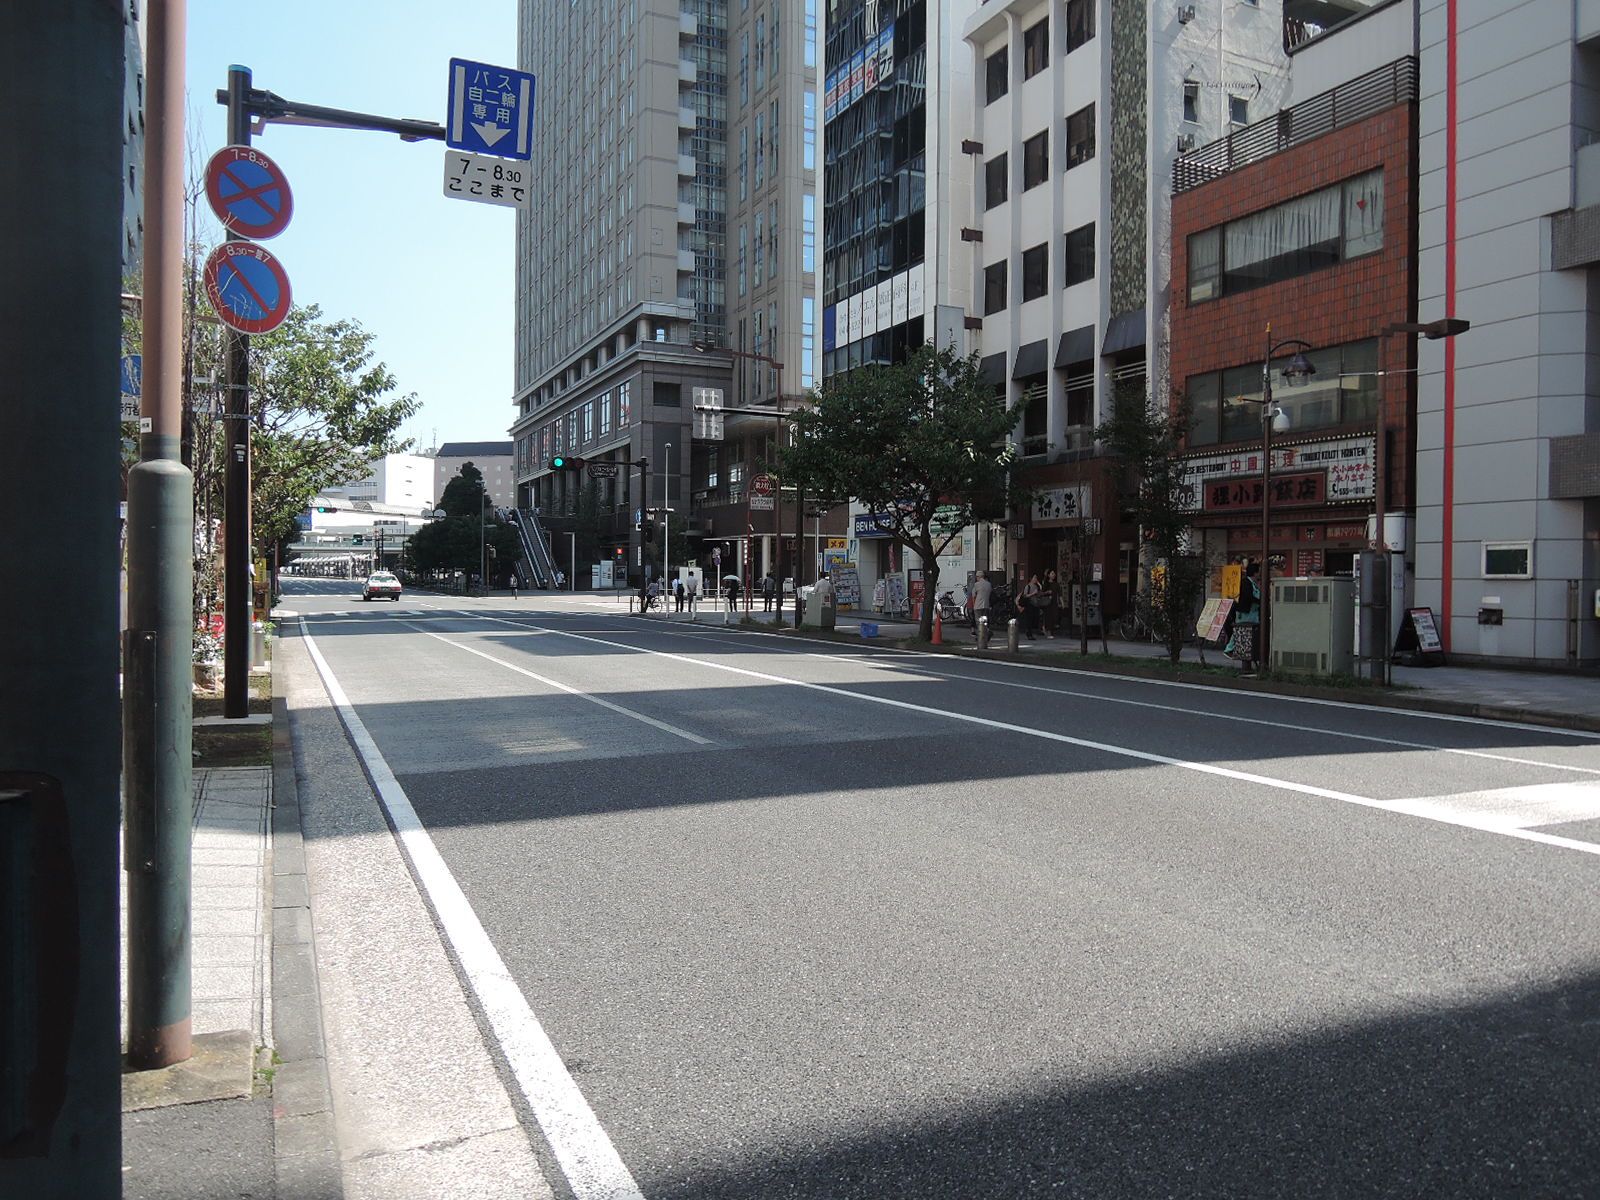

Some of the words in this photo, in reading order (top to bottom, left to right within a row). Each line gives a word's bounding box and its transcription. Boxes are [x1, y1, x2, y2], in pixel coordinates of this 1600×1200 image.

[473, 69, 512, 90] バス
[468, 86, 517, 110] 自二輪
[472, 103, 511, 124] 専用
[460, 158, 522, 184] 7-8.30
[448, 177, 526, 203] ここまで
